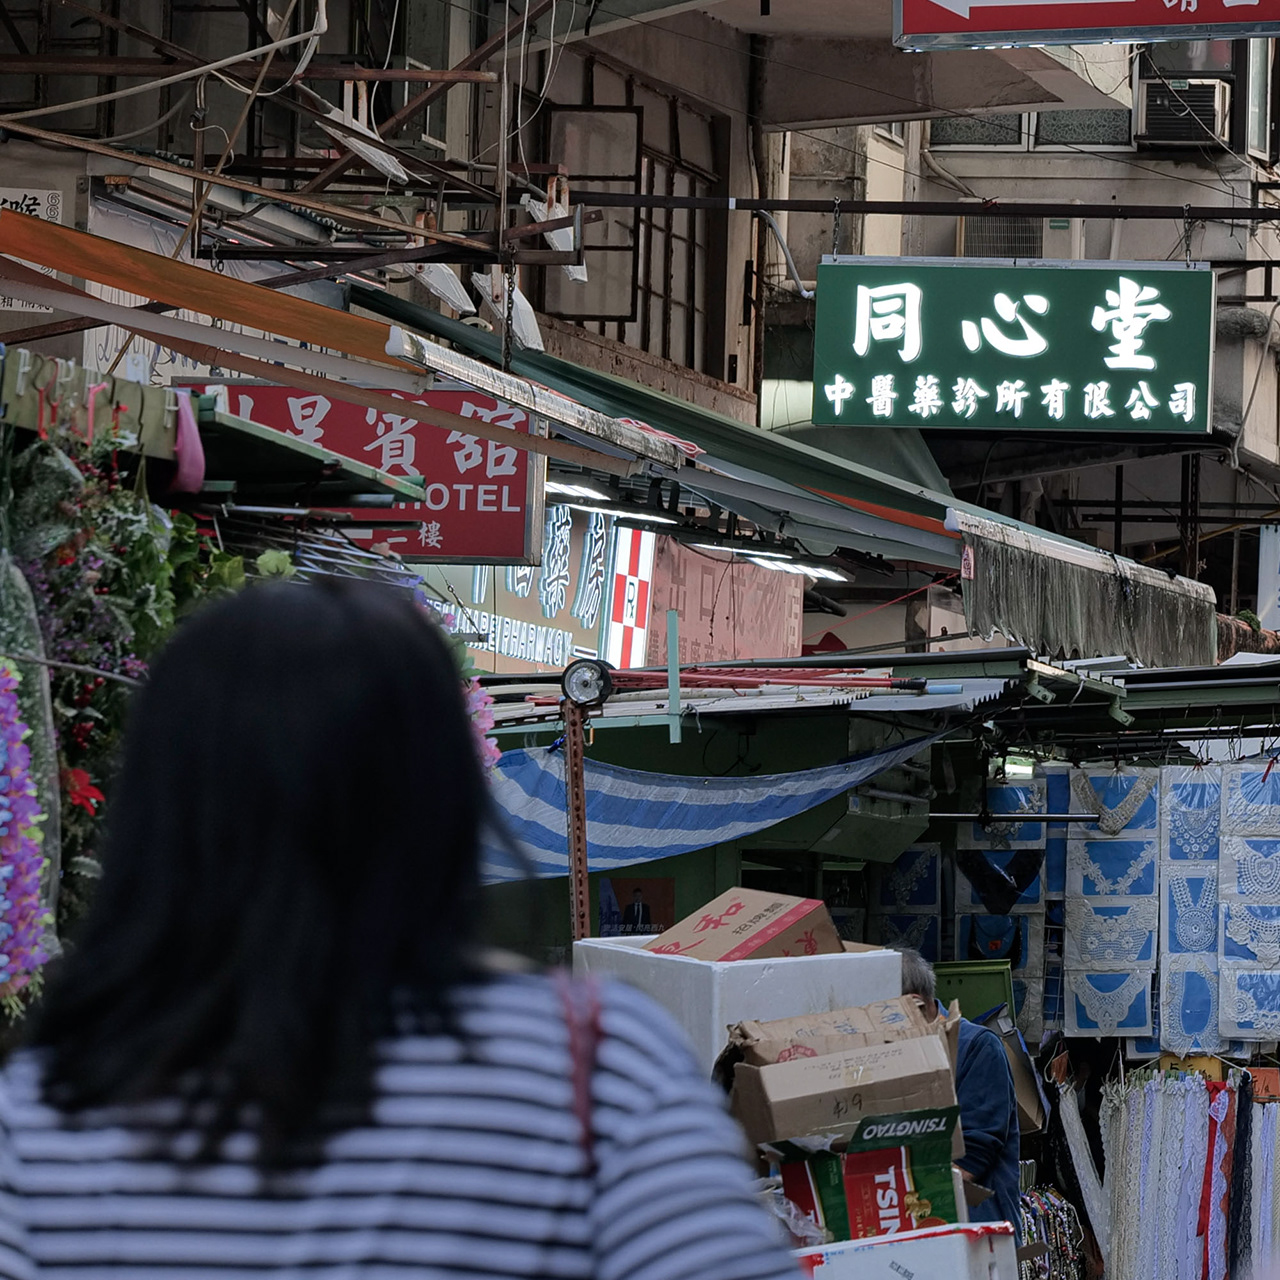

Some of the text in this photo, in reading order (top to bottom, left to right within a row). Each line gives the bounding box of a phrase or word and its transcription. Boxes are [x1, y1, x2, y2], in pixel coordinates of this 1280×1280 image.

[852, 276, 1171, 372] 同心堂
[824, 374, 1197, 424] 中醫藥診所有限公司
[399, 482, 521, 512] OTEL
[863, 1116, 948, 1140] TSINGTAO
